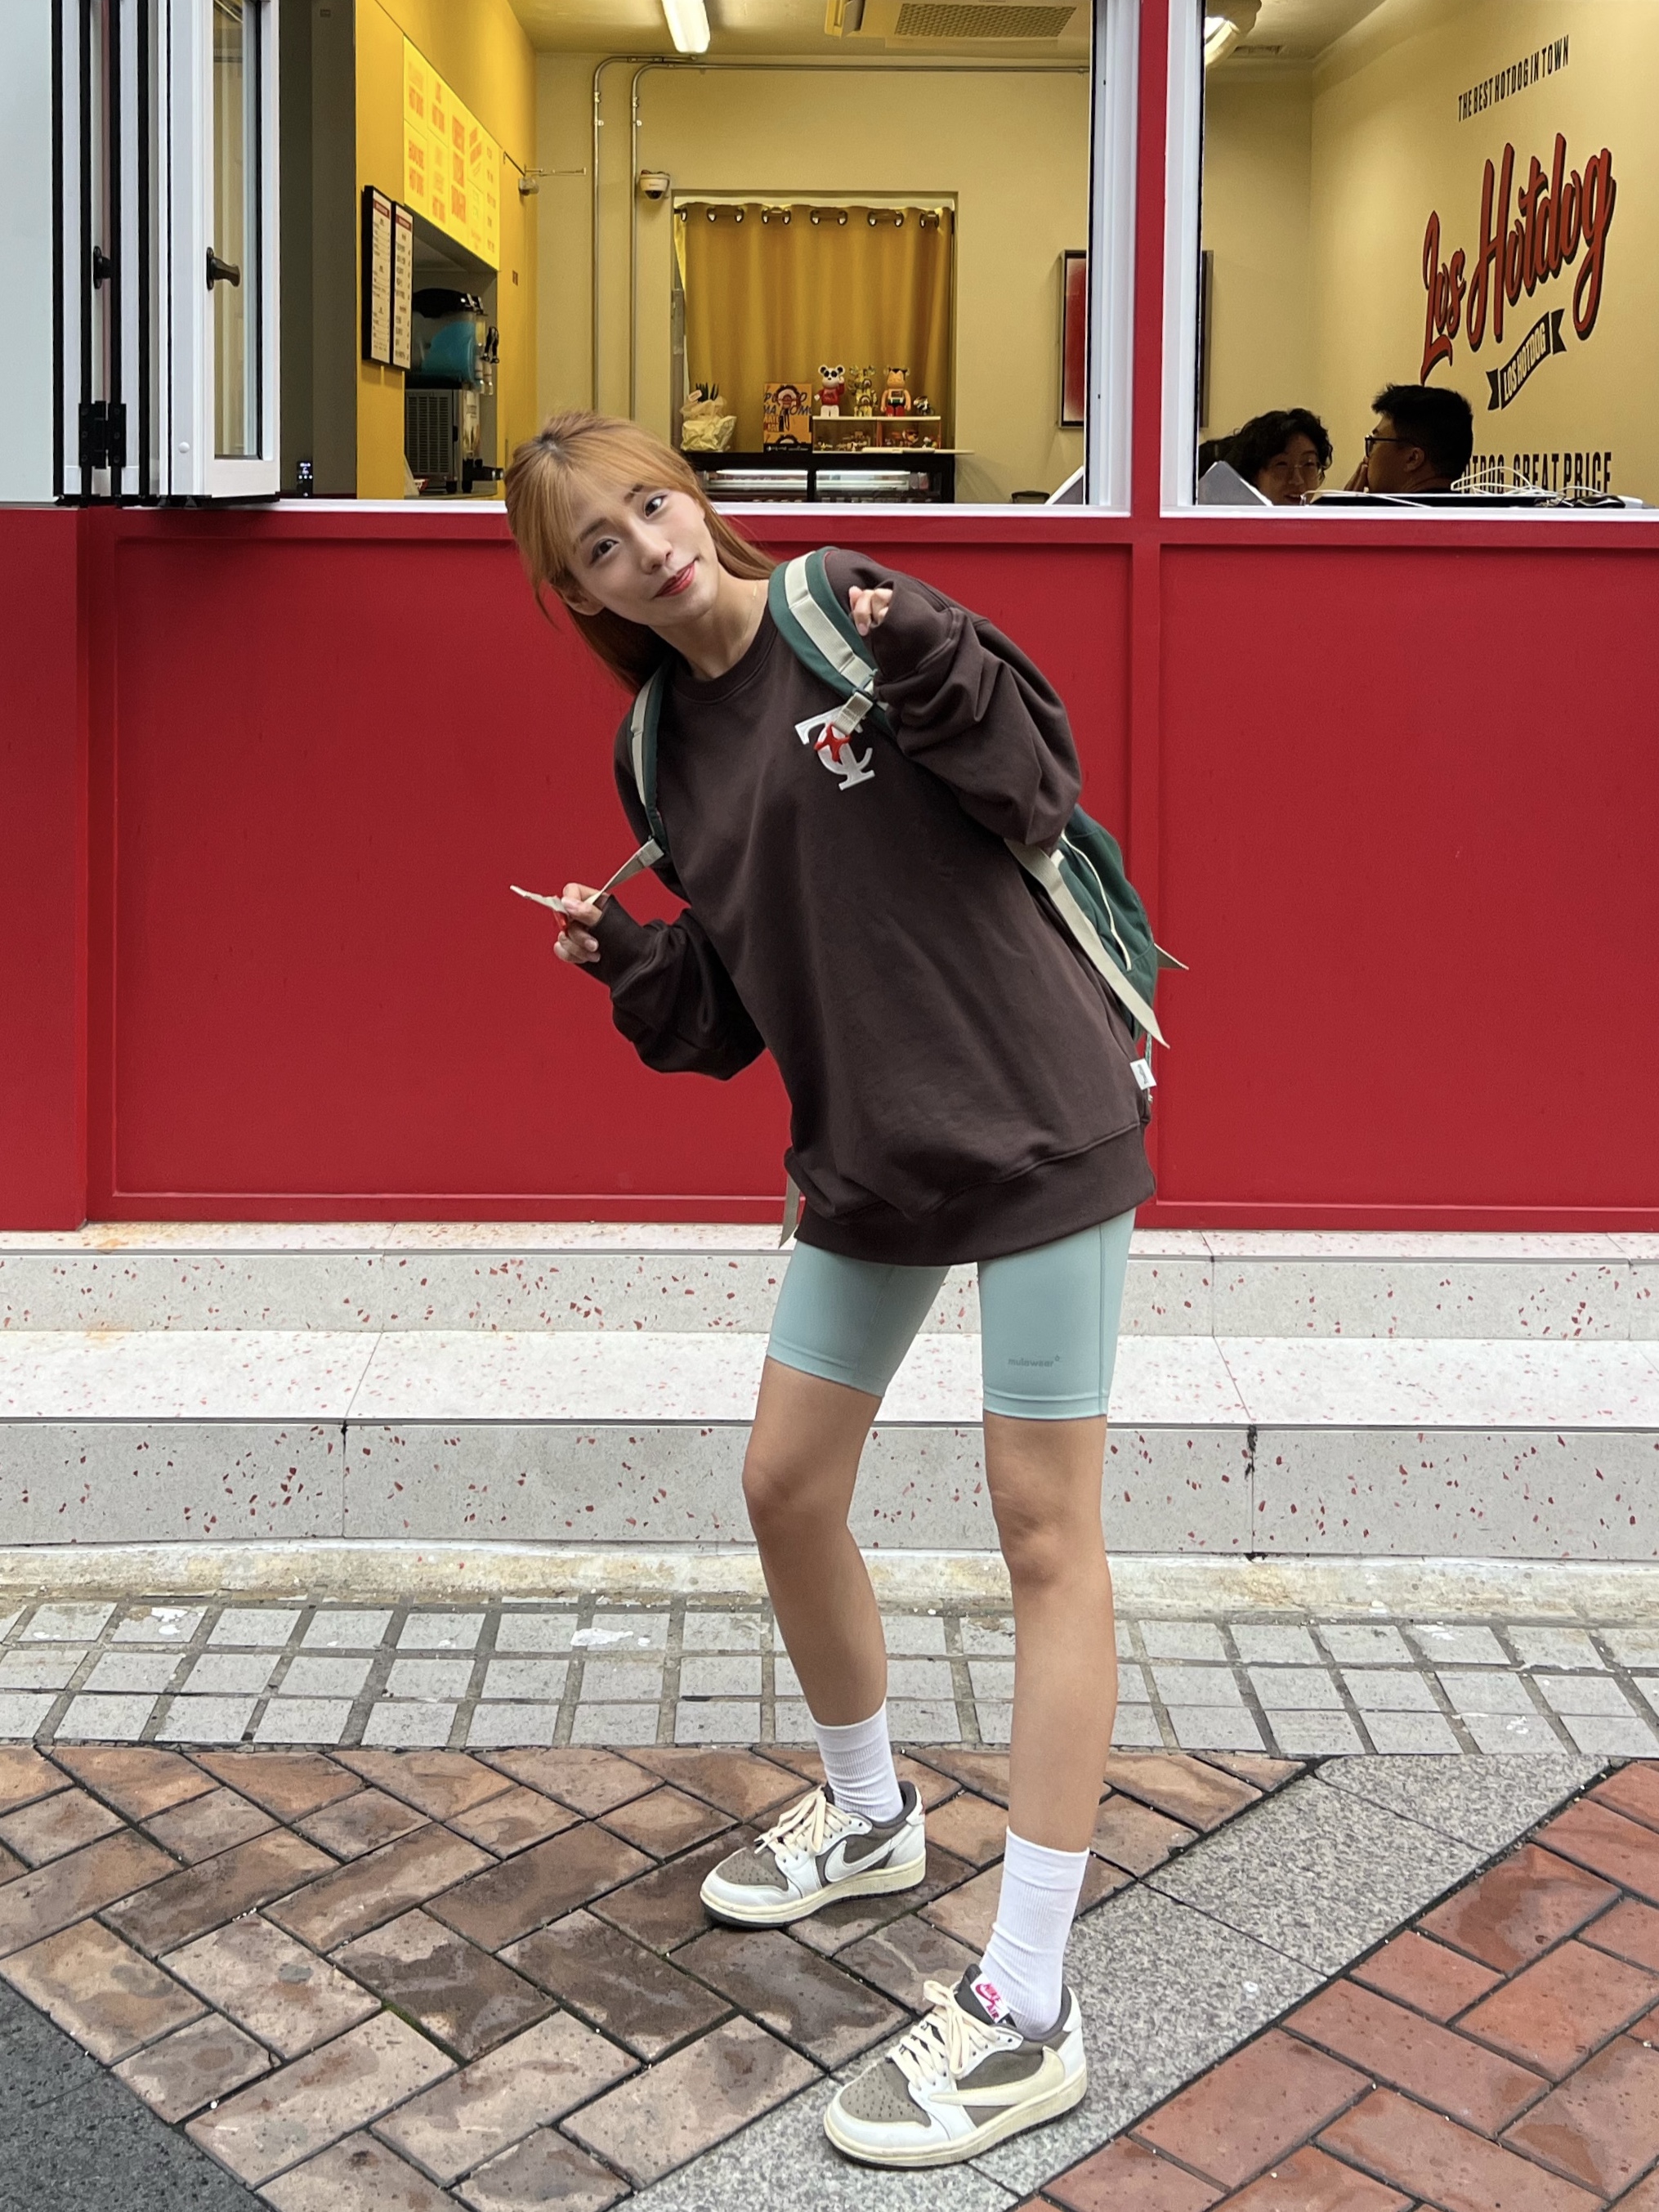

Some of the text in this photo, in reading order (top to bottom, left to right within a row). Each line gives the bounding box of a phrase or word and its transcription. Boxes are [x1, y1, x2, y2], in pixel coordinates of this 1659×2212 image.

[1458, 34, 1569, 123] THE BEST HOTDOG IN TOWN
[1420, 132, 1617, 387] Los Hotdog
[1513, 453, 1559, 495] GREAT
[1563, 451, 1612, 498] PRICE
